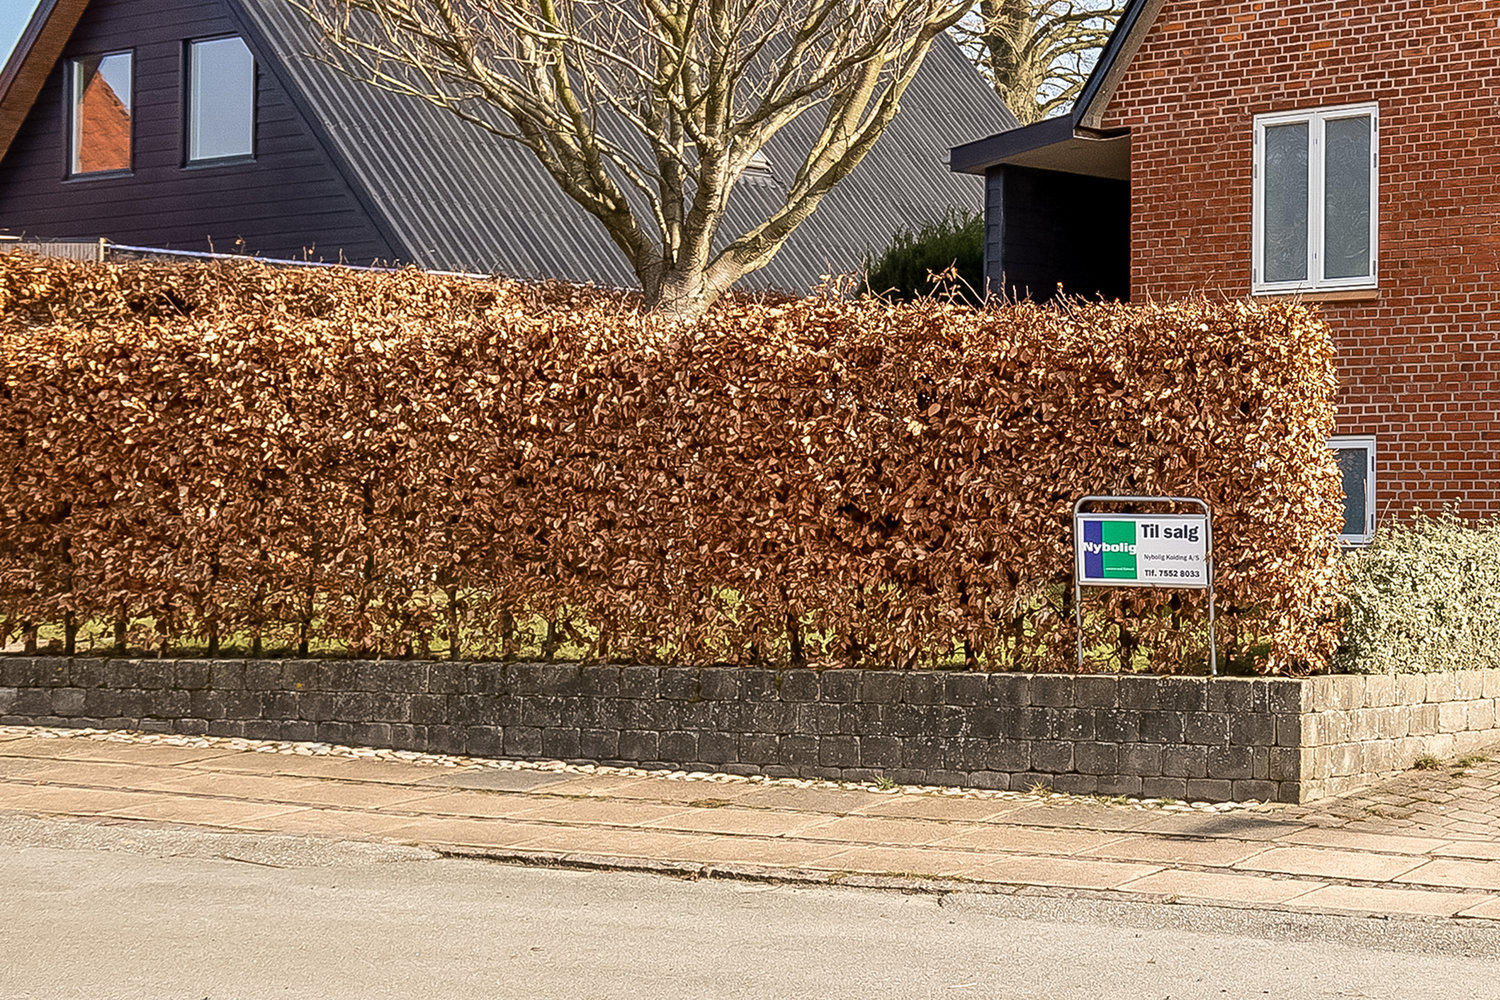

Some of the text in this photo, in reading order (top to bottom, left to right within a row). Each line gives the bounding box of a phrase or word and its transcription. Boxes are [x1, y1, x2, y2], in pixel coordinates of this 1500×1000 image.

[1141, 524, 1199, 542] Til salg
[1083, 542, 1137, 555] Nybolig
[1180, 570, 1200, 578] 8033
